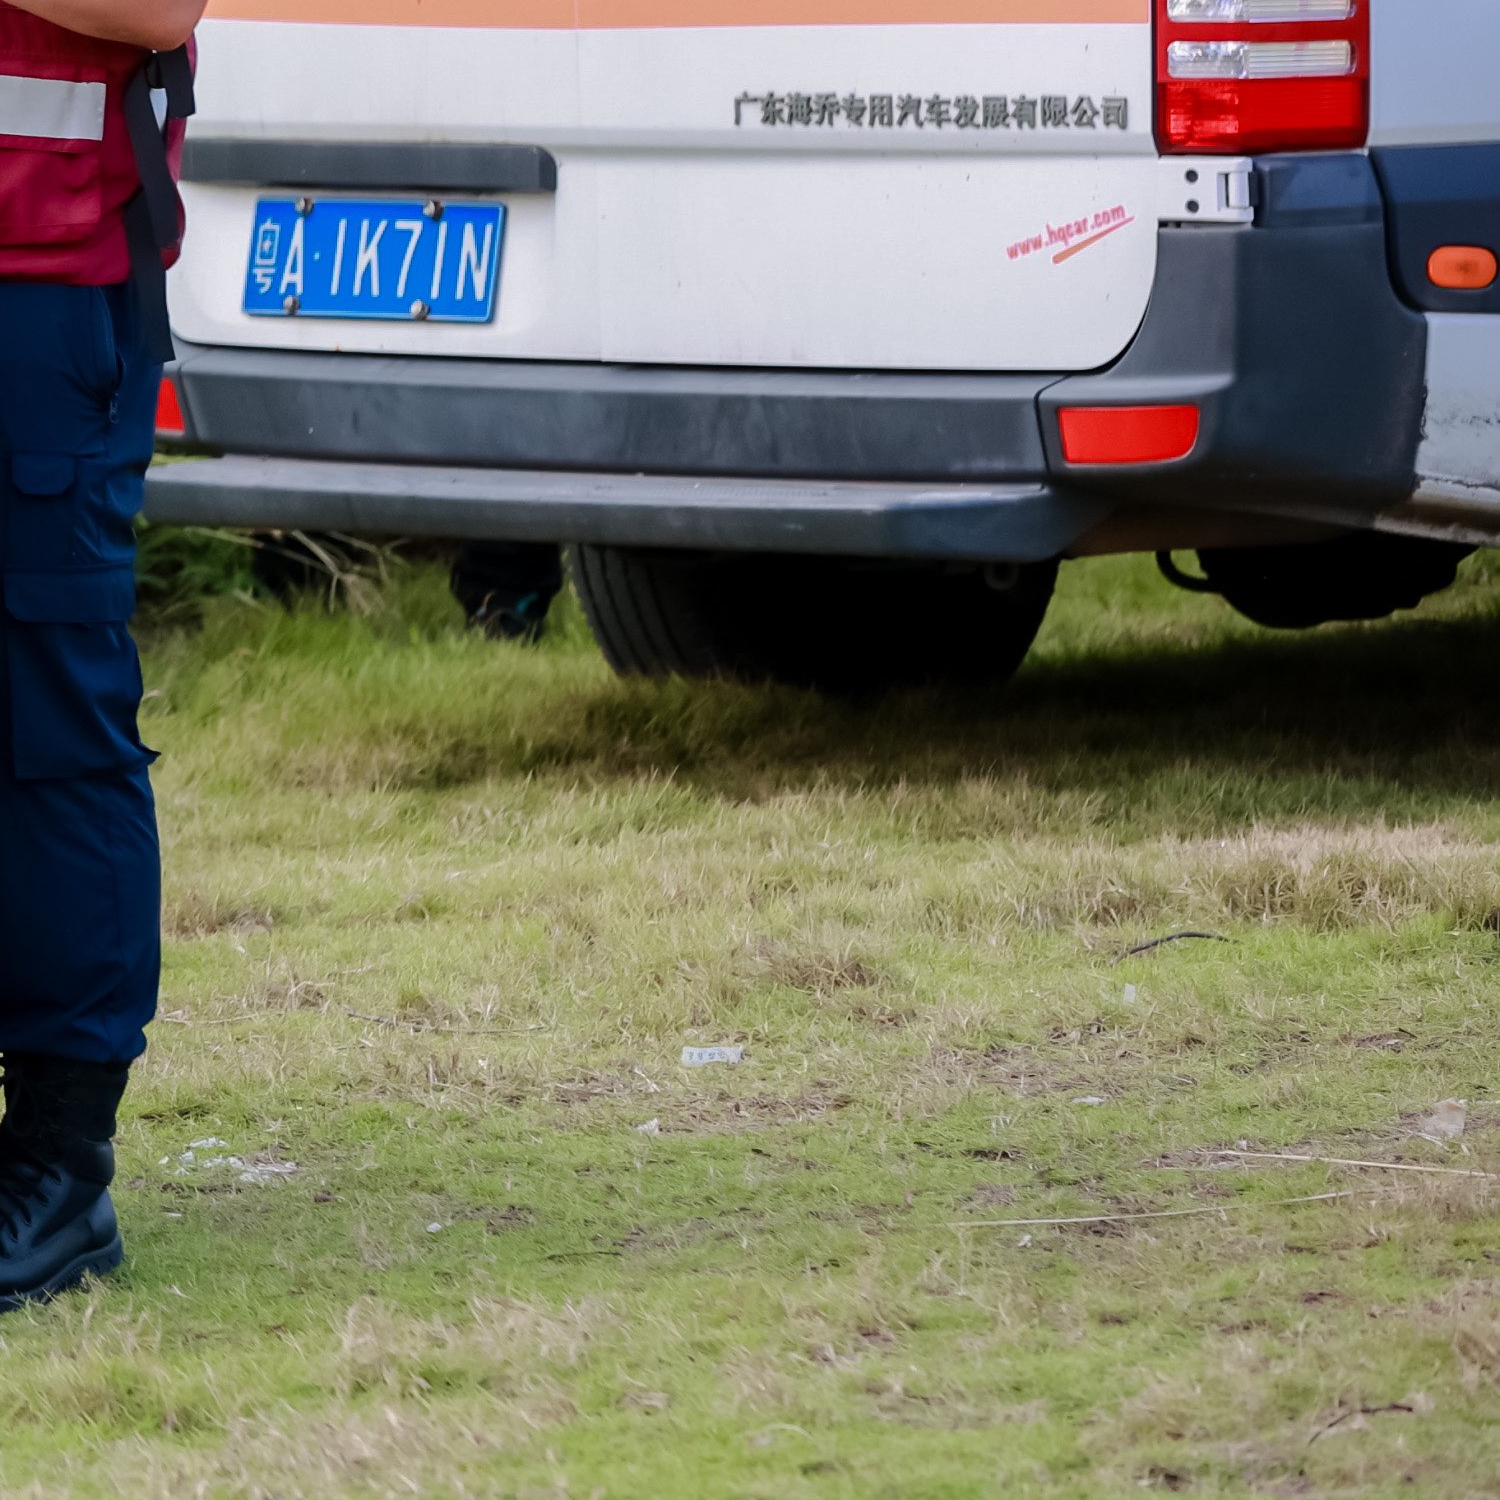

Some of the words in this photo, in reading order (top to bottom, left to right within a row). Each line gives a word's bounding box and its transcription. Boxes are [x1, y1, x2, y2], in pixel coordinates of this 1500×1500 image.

[734, 92, 1128, 130] 广东海乔专用汽车发展有限公司
[1006, 204, 1126, 261] www.hqcar.com
